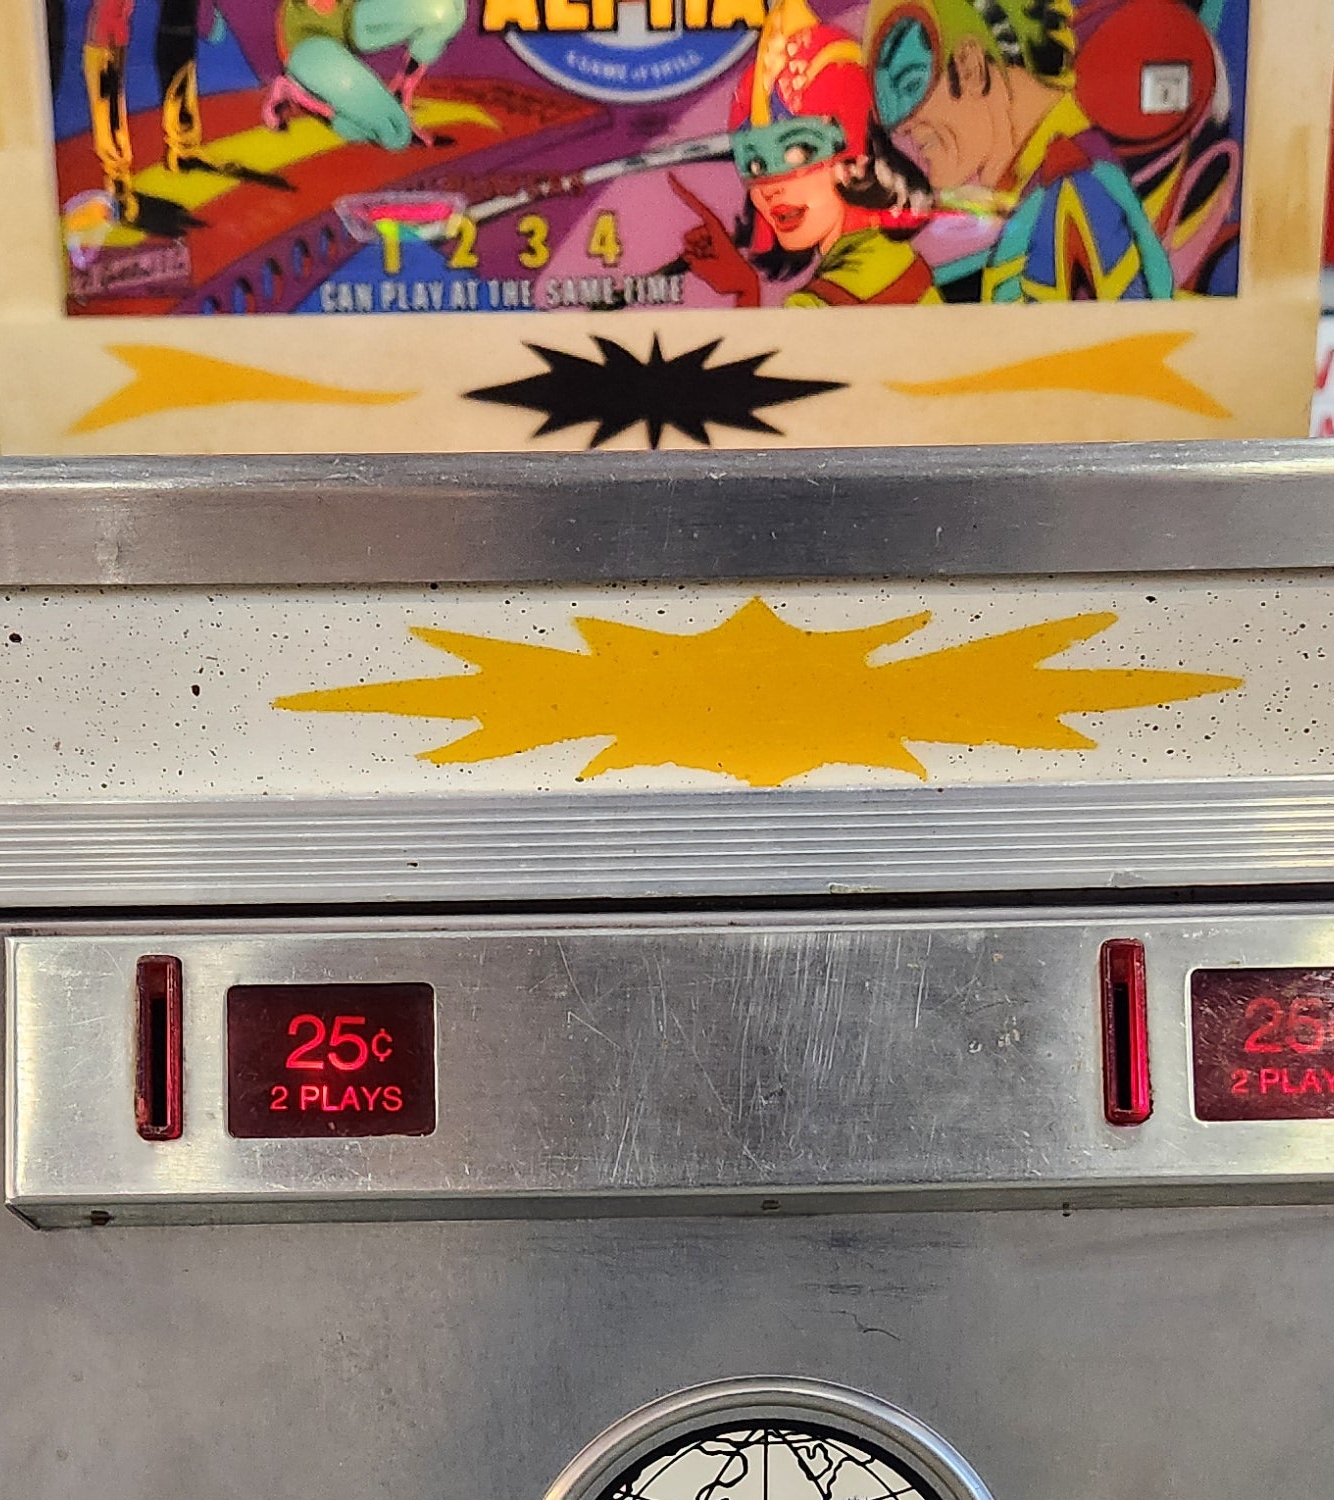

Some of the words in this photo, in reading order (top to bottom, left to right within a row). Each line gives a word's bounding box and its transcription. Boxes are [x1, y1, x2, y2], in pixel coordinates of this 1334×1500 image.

[375, 219, 402, 274] 1
[446, 216, 479, 269] 2
[517, 214, 550, 269] 3
[587, 210, 624, 268] 4
[320, 281, 372, 313] CAN
[381, 280, 444, 311] PLAY
[450, 279, 479, 311] AT
[488, 277, 533, 308] THE
[546, 276, 617, 307] SAME
[624, 273, 683, 305] TIME
[285, 1013, 393, 1071] 25¢
[269, 1086, 288, 1110] 2
[299, 1085, 403, 1111] PLAYS
[1231, 1069, 1249, 1095] 2
